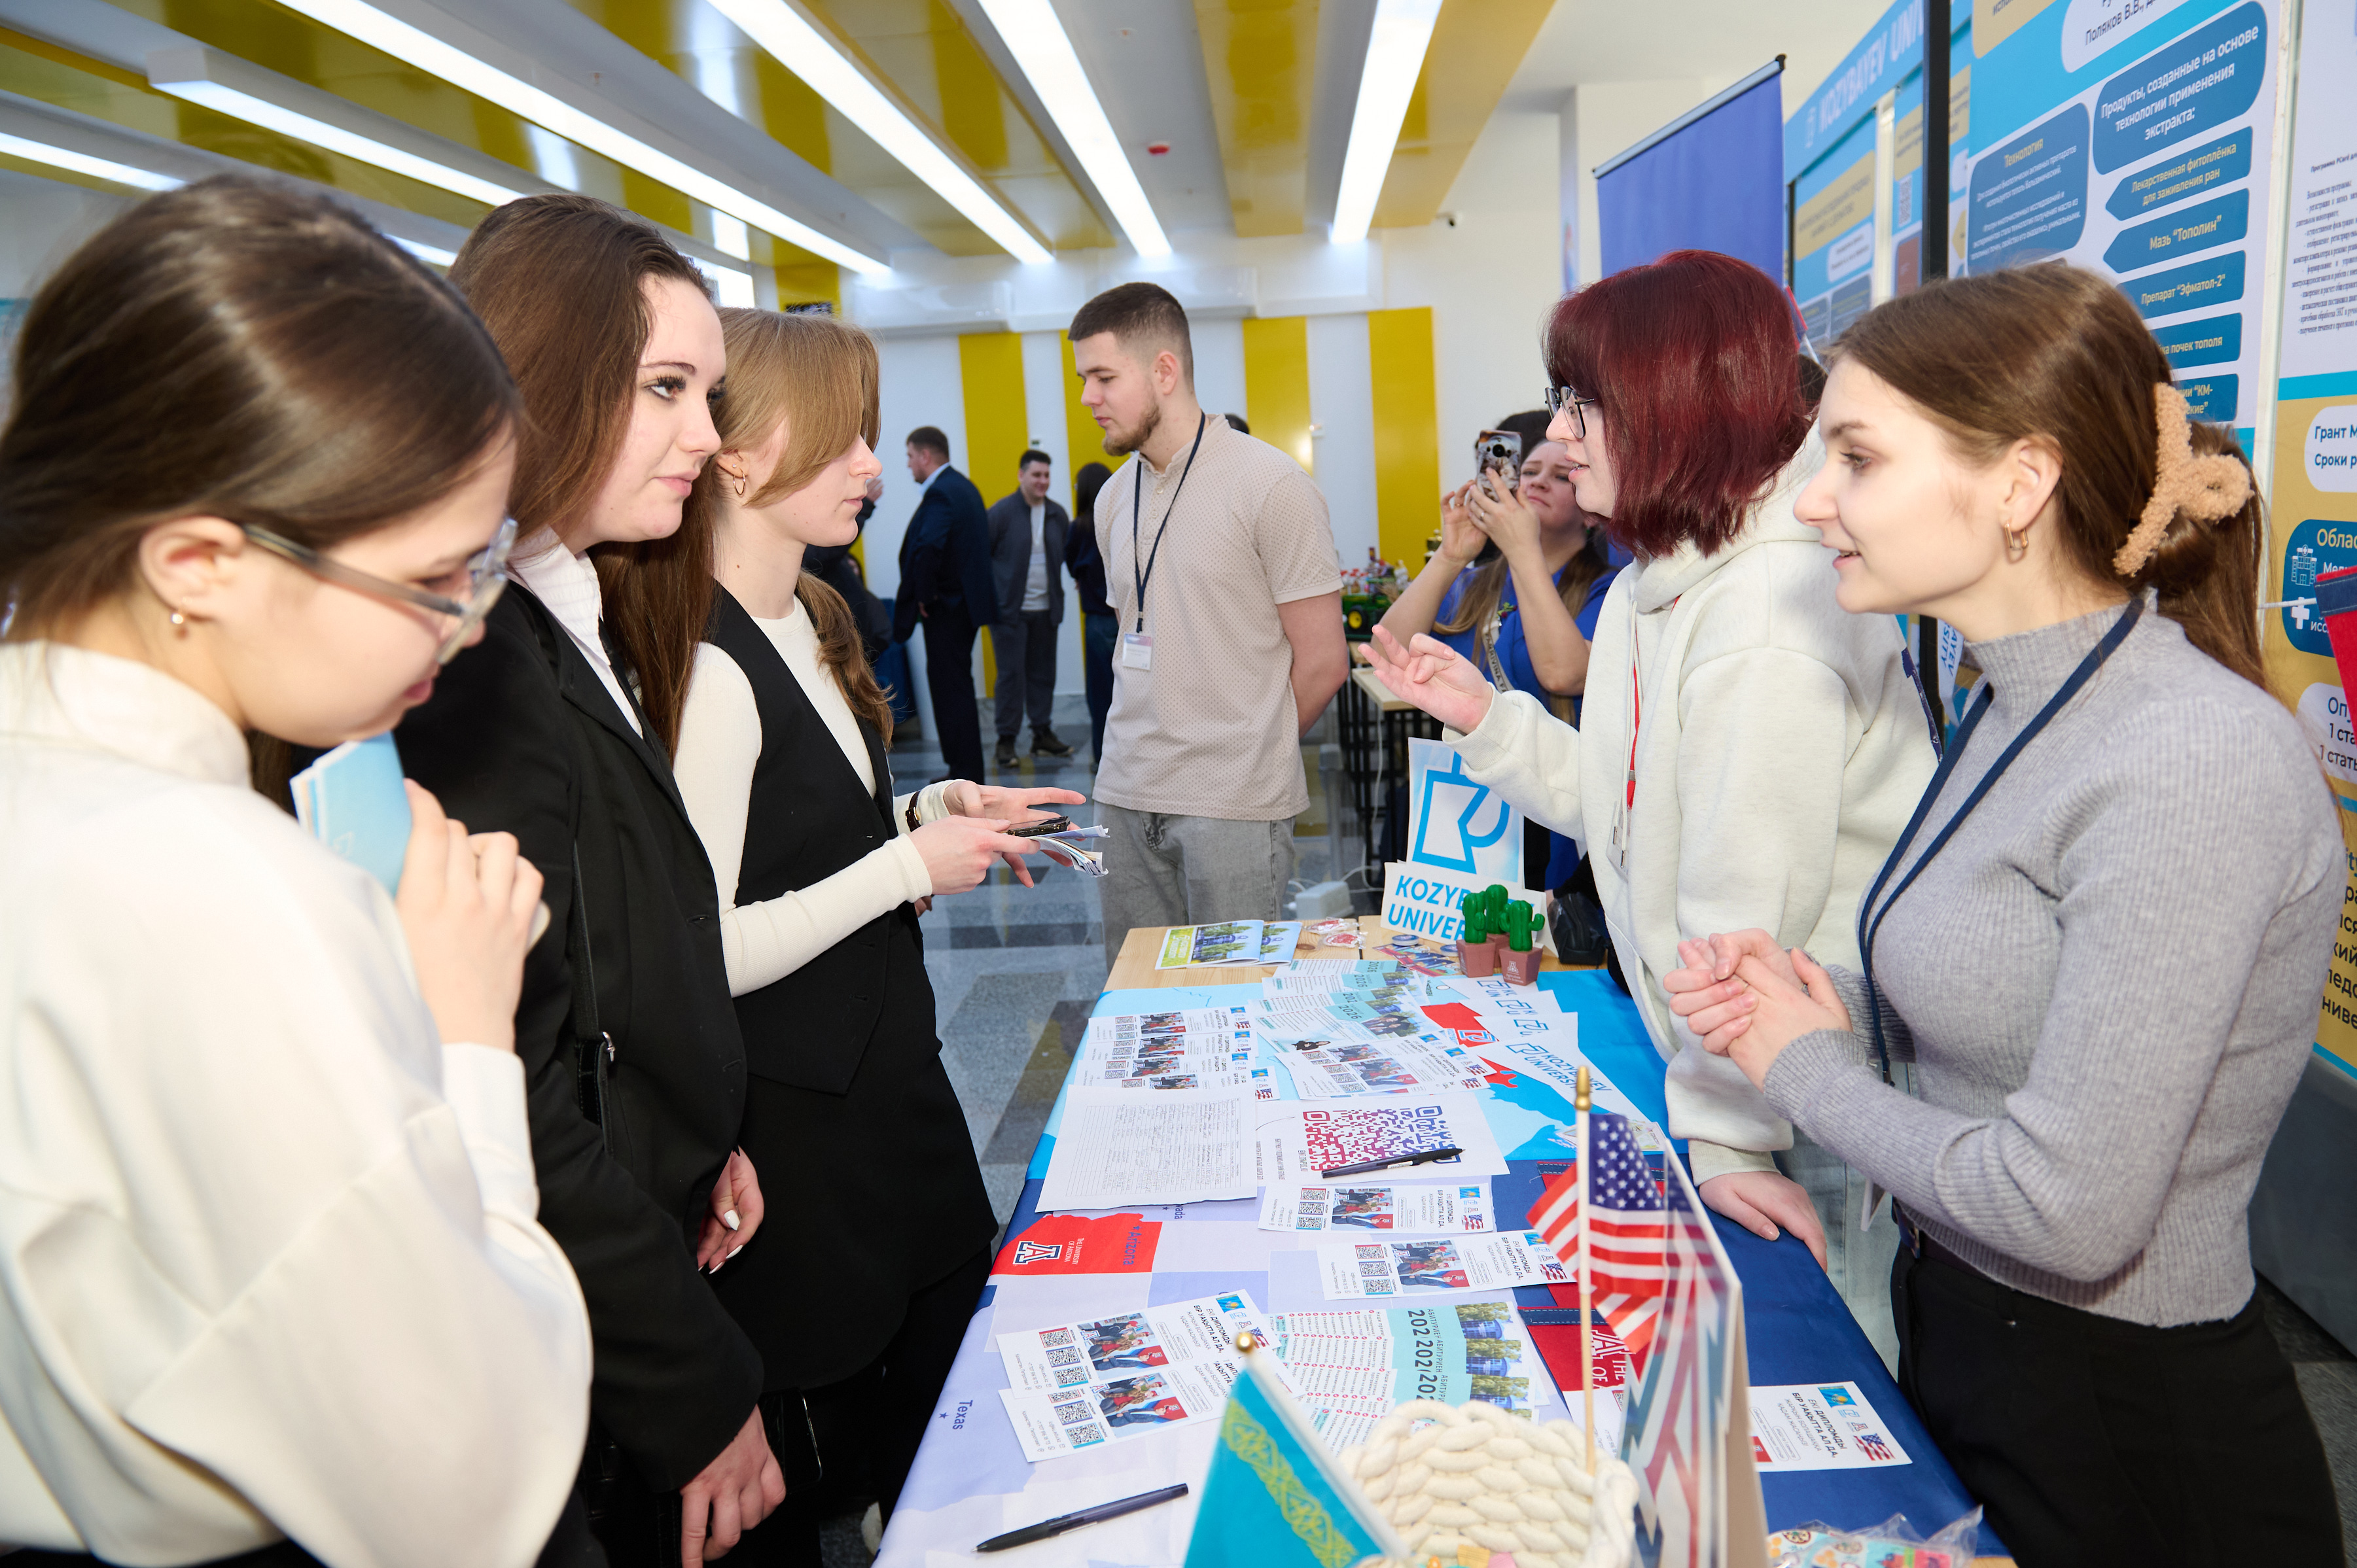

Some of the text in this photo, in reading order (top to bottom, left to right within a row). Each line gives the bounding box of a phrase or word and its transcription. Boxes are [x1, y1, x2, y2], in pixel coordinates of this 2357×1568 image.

[2085, 12, 2122, 45] Поляков
[2100, 26, 2259, 118] Продукты, созданные на основе
[2116, 63, 2235, 132] технологии применения
[2144, 107, 2195, 140] экстракта:
[2004, 138, 2044, 167] Технология
[2131, 143, 2237, 193] Лекарственная фитоплёнка
[2142, 168, 2220, 206] для заживления ран
[2150, 235, 2171, 250] Мазь
[2141, 288, 2176, 305] Препарат
[2171, 341, 2193, 354] почек
[2195, 336, 2223, 349] тополя
[2314, 426, 2347, 443] Грант
[2314, 453, 2347, 469] Сроки
[1367, 961, 1379, 973] 2026
[1354, 975, 1368, 988] 2026
[1338, 1005, 1362, 1019] 2026
[1064, 1246, 1074, 1263] ARIZONA
[1072, 1245, 1082, 1264] UNIVERSITY
[1123, 1232, 1142, 1265] Arizona
[1504, 1244, 1517, 1264] УАҚЫТТА
[1515, 1248, 1532, 1274] ДИПЛОМДЫ
[1198, 1313, 1215, 1335] УАҚЫТТА
[1214, 1344, 1224, 1353] ДА,
[1210, 1317, 1232, 1345] ДИПЛОМДЫ
[1408, 1310, 1430, 1339] 202
[1415, 1340, 1433, 1372] 202
[1213, 1361, 1232, 1384] АҚЫТТА
[1592, 1367, 1608, 1382] OF
[952, 1400, 973, 1430] Texas
[1778, 1403, 1791, 1420] ҚАДАМ
[1785, 1399, 1822, 1452] ЖАРҚЫН БОЛАШАҚҚА
[1792, 1393, 1838, 1458] БІР УАҚЫТТА АЛ ДА,
[1808, 1399, 1847, 1449] ЕКІ ДИПЛОМДЫ
